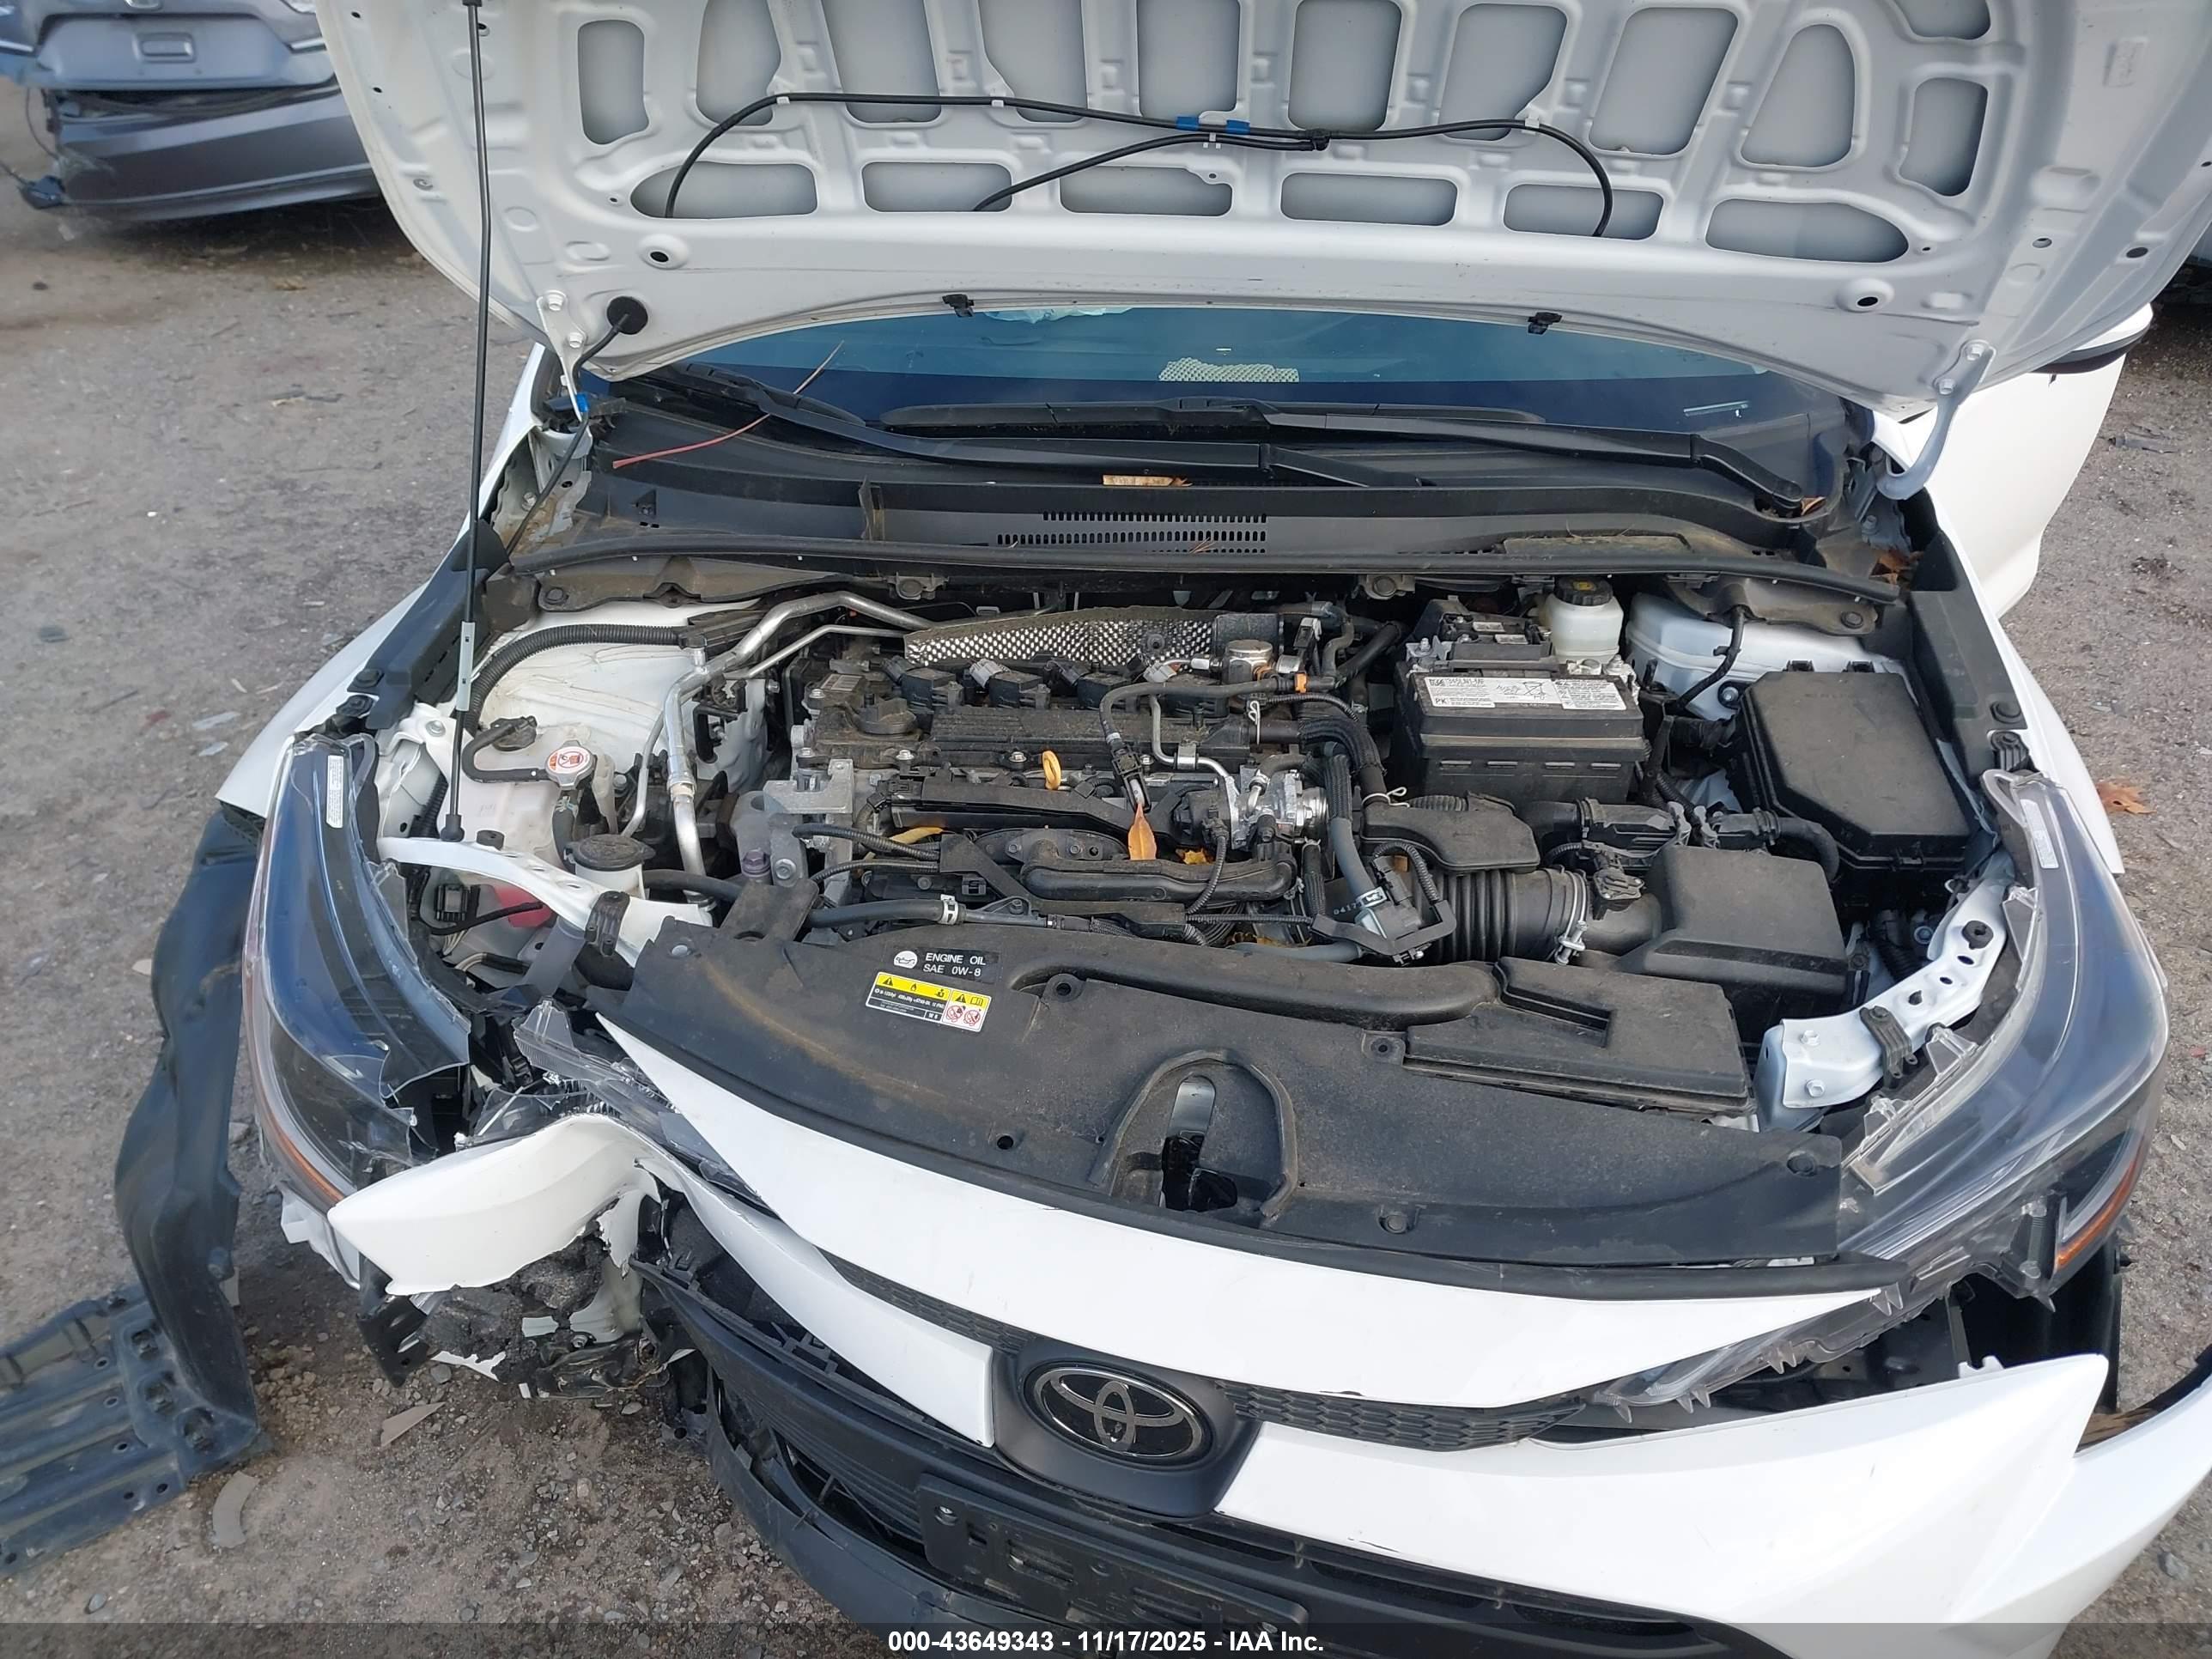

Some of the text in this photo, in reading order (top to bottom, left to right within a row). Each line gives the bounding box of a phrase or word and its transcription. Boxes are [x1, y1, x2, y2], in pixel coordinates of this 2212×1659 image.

[925, 952, 987, 966] ENGINE OIL
[922, 963, 981, 977] SAE 0W-8
